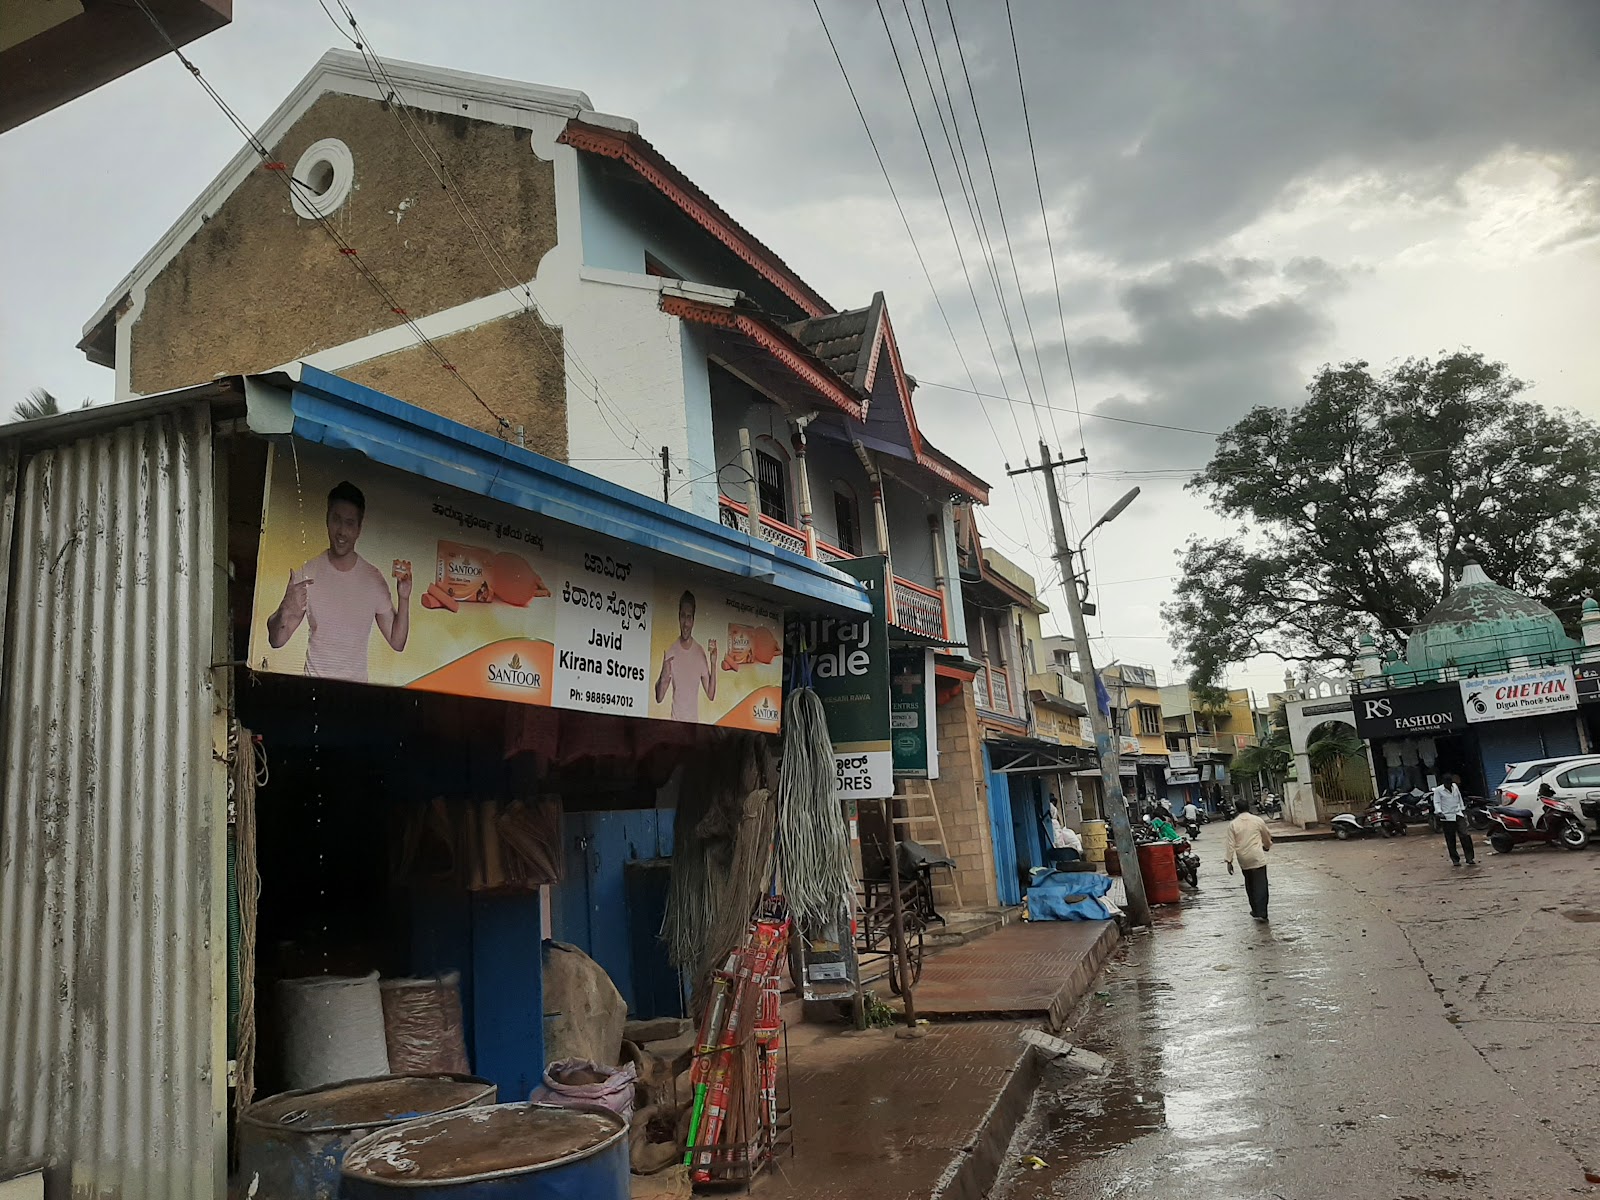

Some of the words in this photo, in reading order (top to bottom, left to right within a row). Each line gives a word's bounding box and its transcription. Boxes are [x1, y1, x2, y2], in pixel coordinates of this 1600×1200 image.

[448, 561, 483, 577] SANTOOR
[588, 628, 623, 651] Javid
[785, 619, 870, 649] ajraj
[487, 663, 541, 687] SANTOOR
[559, 650, 602, 675] Kirana
[606, 658, 645, 681] Stores
[569, 688, 583, 702] Ph:
[585, 691, 634, 708] 9886947012
[850, 693, 871, 701] RAWA
[1495, 678, 1567, 701] CHETAN
[753, 705, 779, 720] SANTOOR
[892, 702, 919, 710] ENTRES
[1362, 698, 1393, 720] RS
[1394, 712, 1453, 729] FASHION
[836, 776, 872, 791] ORES
